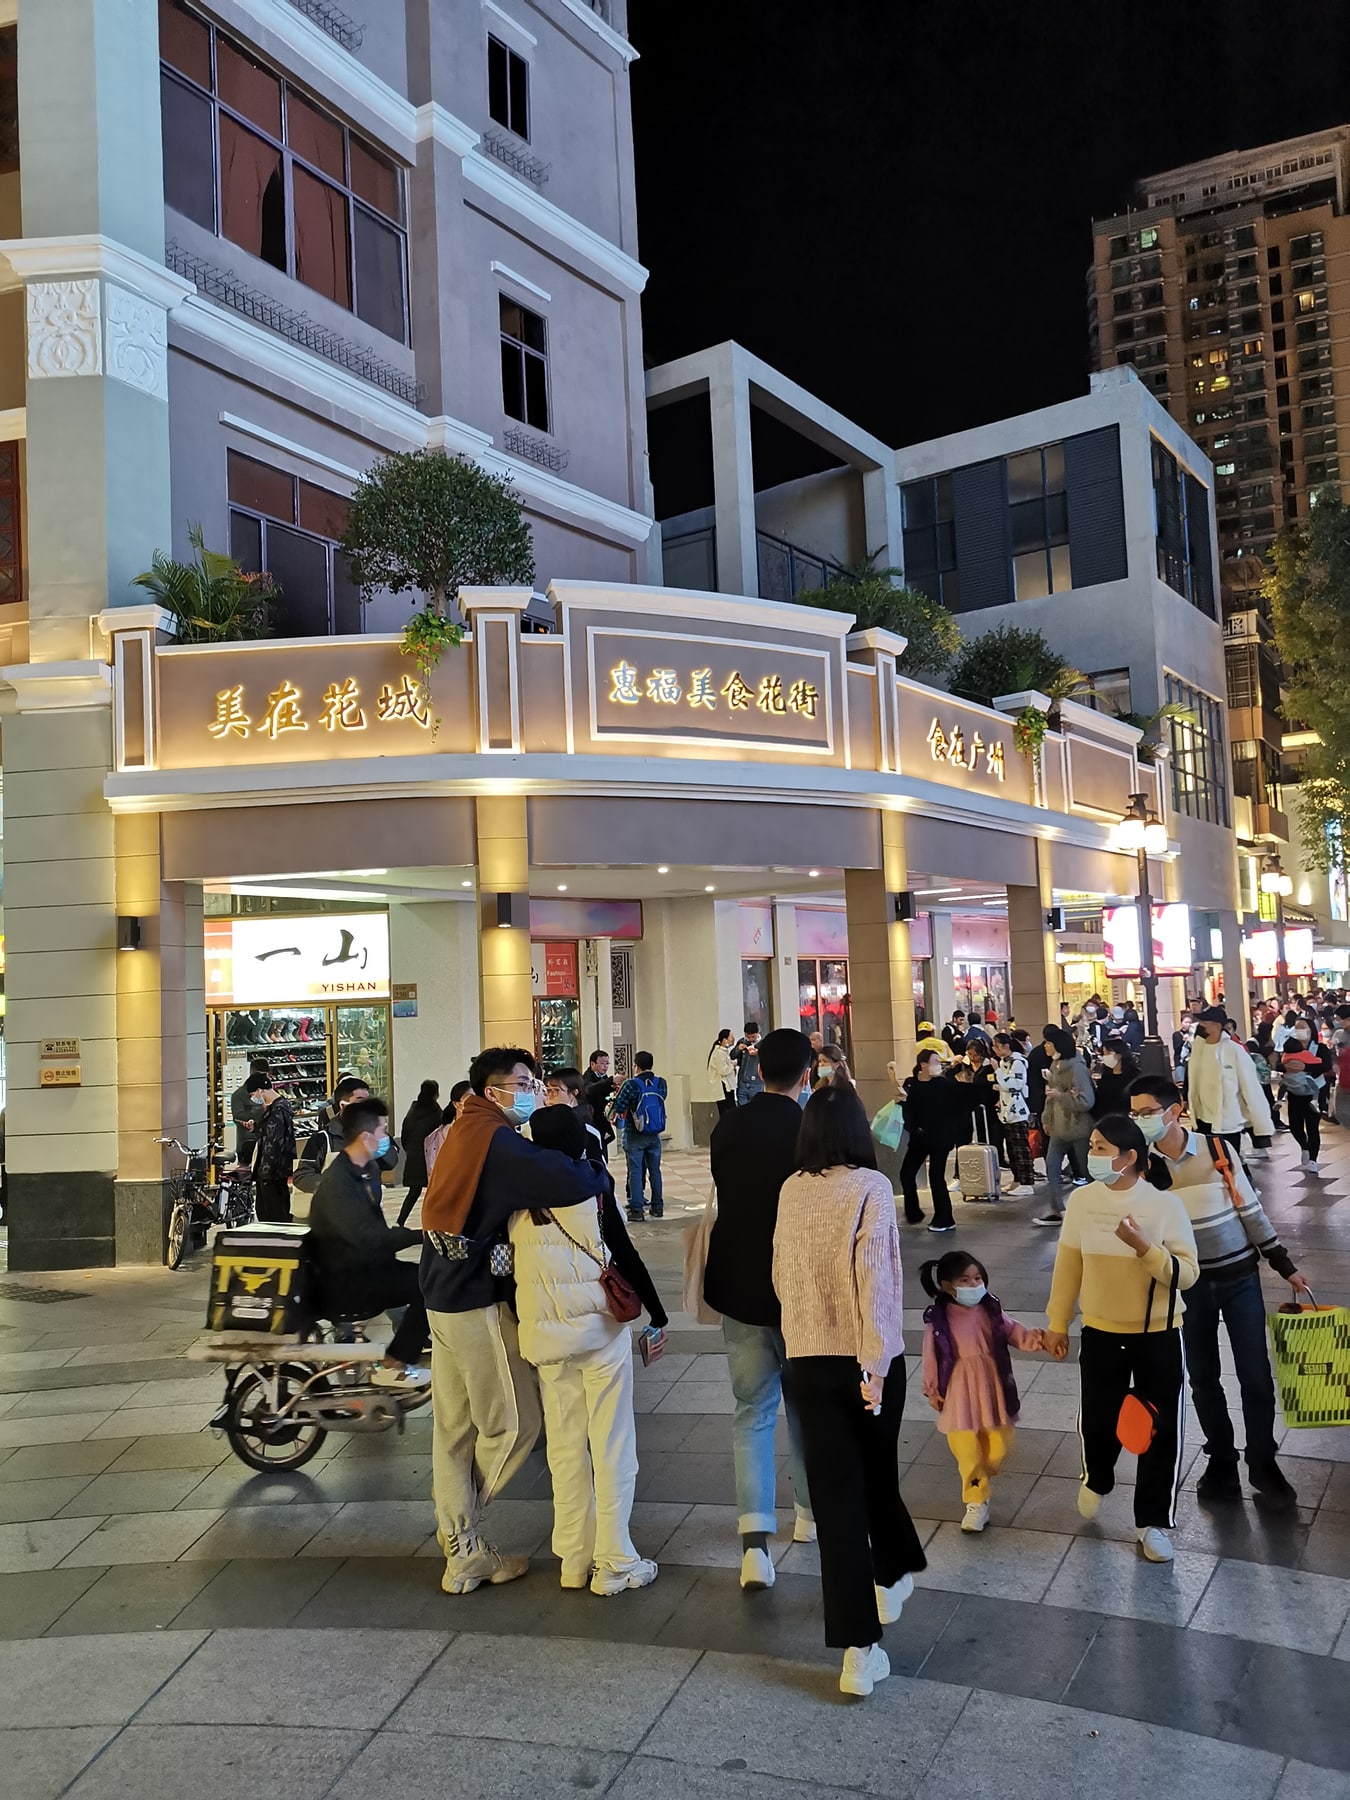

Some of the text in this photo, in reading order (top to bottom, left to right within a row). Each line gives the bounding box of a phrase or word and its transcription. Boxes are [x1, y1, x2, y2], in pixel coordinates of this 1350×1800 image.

[207, 674, 431, 739] 美在花城
[609, 660, 819, 720] 惠福美食花街
[926, 717, 1005, 782] 食在广州
[254, 929, 368, 970] 一山
[322, 982, 378, 992] YISHAN
